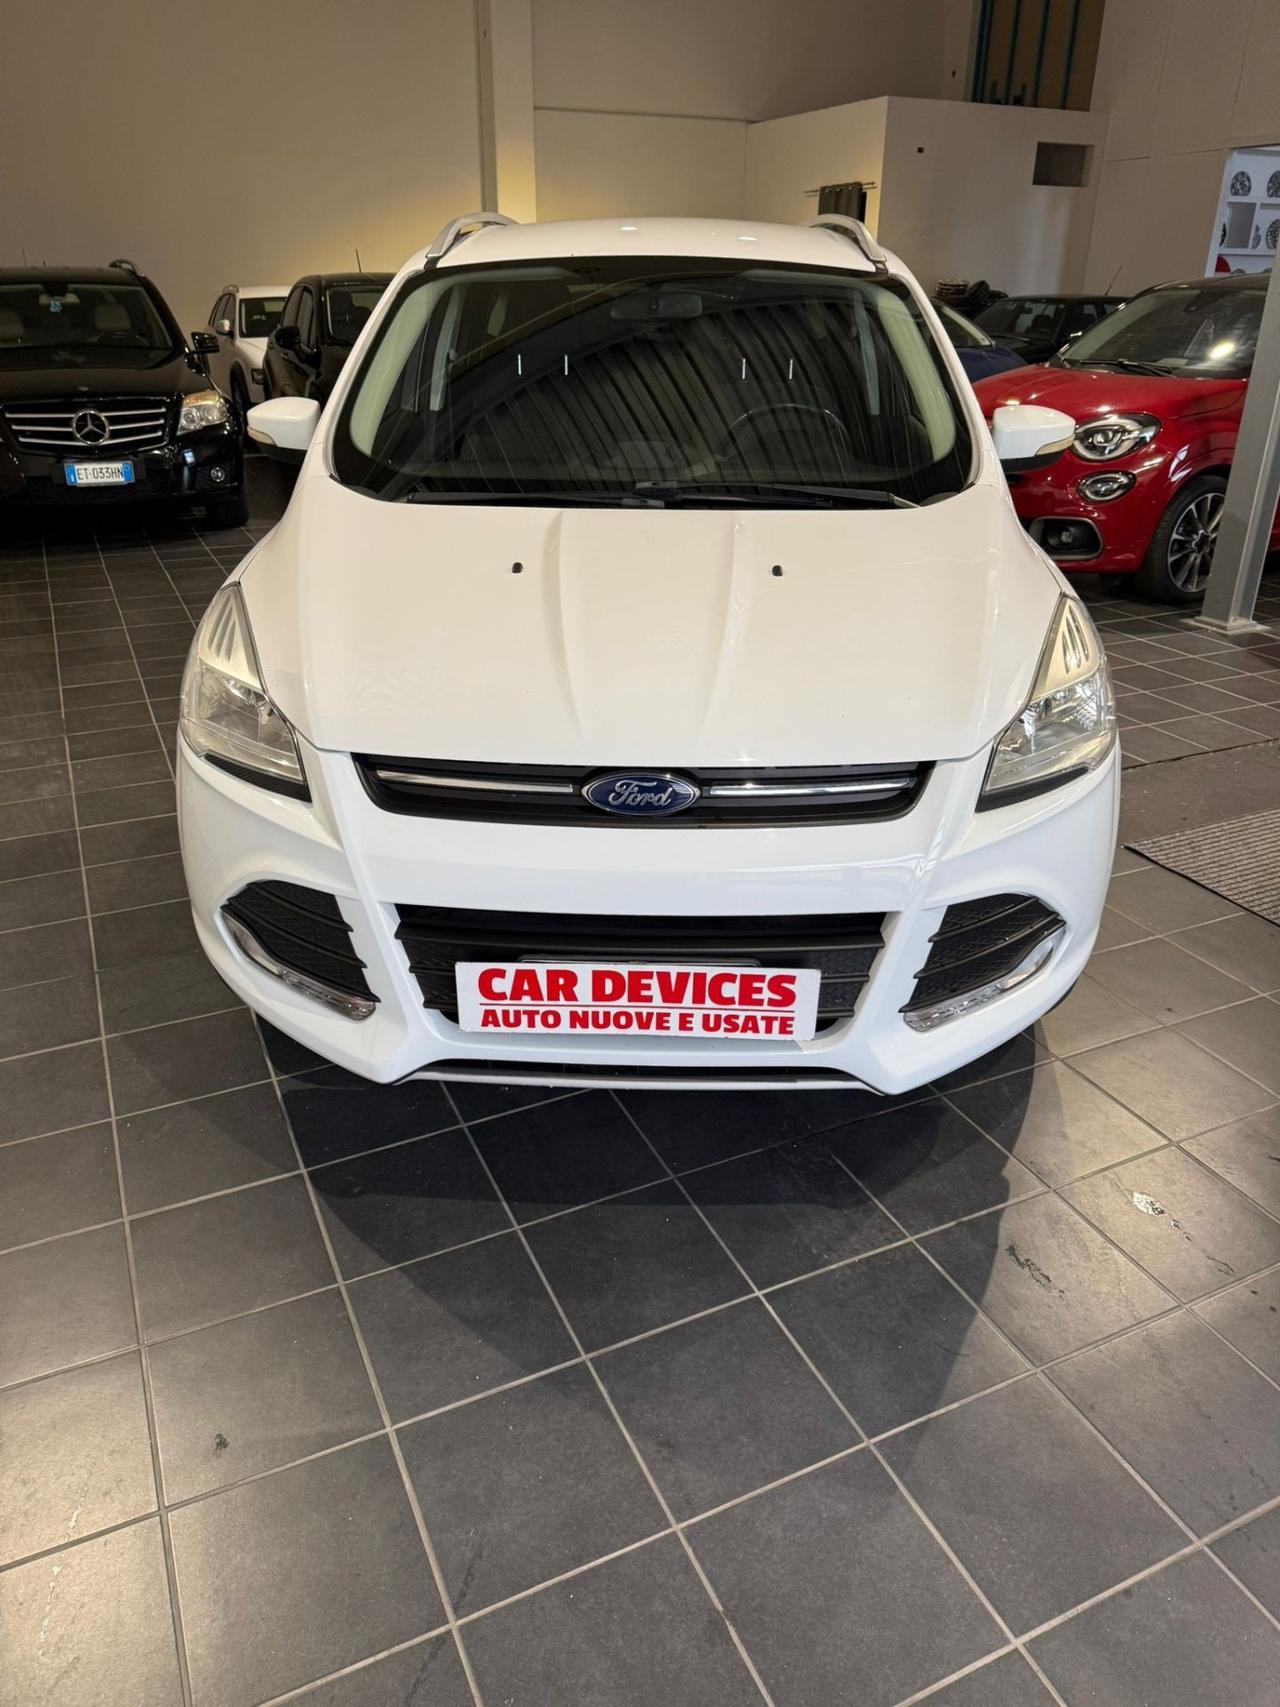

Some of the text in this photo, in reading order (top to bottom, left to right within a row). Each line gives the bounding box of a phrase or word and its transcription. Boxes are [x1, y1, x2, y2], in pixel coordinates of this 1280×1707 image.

[608, 780, 673, 806] Ford
[477, 968, 797, 1008] CAR DEVICES
[481, 1009, 794, 1036] AUTO NUOVE E USATE
